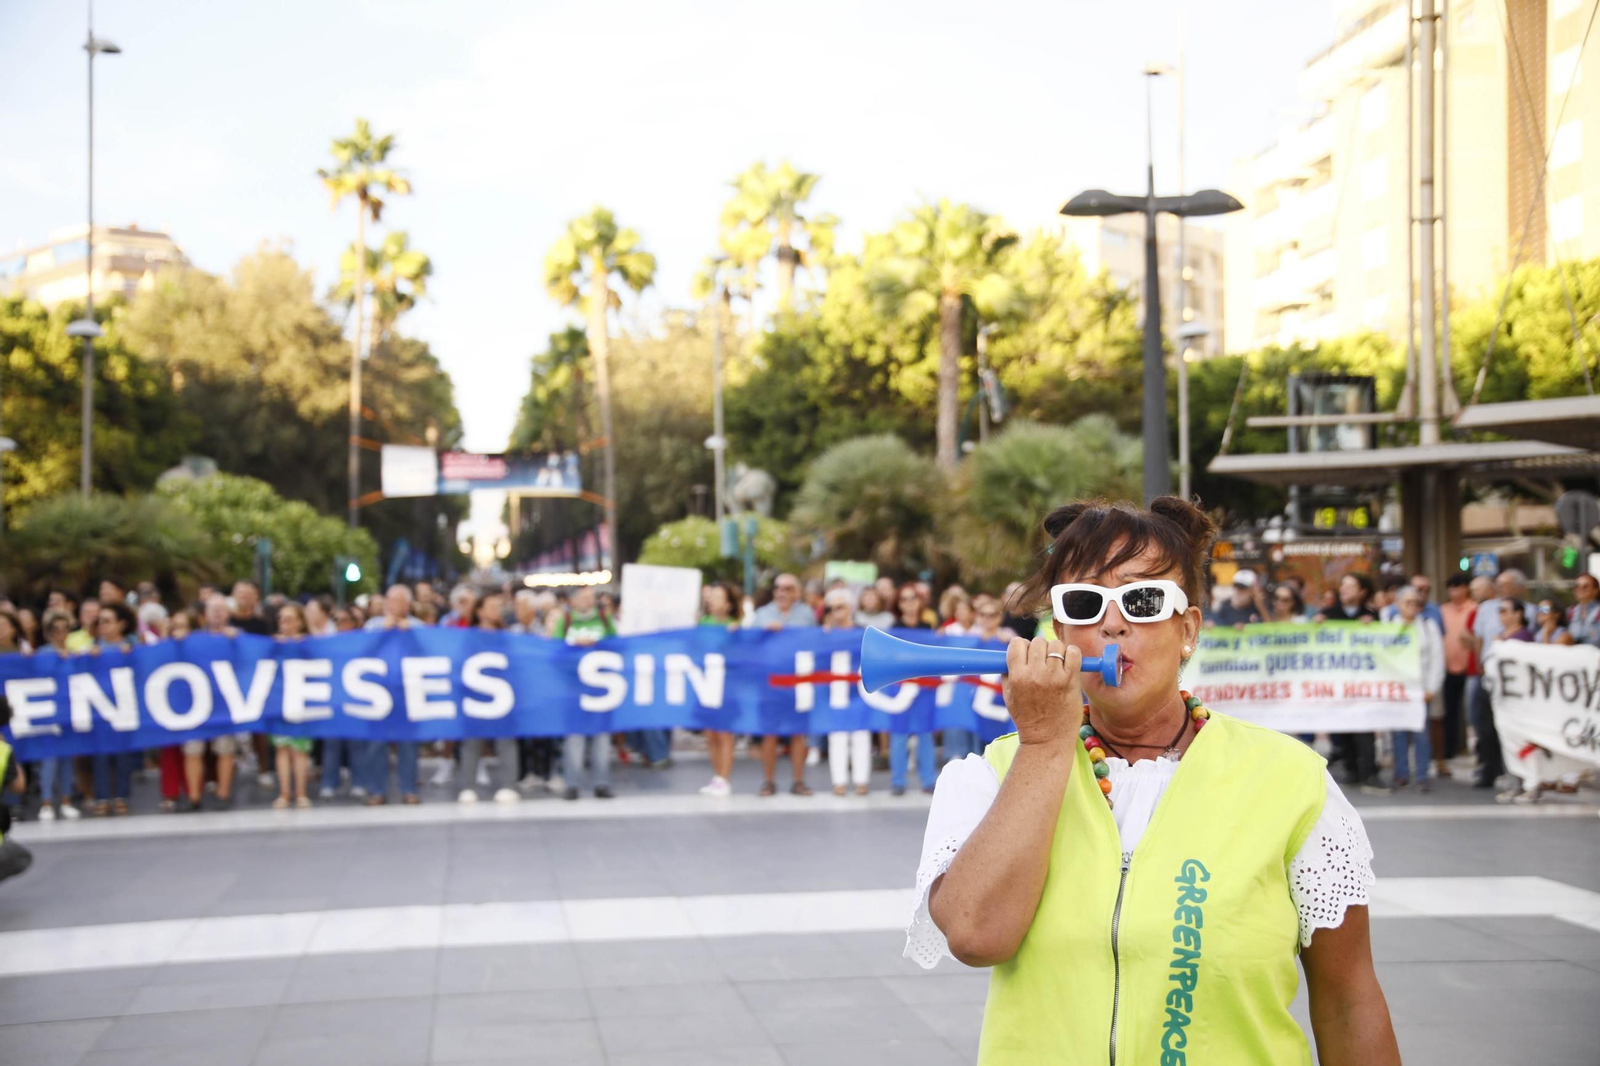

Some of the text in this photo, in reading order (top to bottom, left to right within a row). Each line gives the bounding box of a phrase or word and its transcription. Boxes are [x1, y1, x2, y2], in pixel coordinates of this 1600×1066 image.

[577, 650, 726, 713] SIN
[1265, 652, 1376, 676] QUEREMOS
[1193, 680, 1408, 702] GENOVESES SIN HOTEL
[1160, 858, 1211, 1066] GREENPEACE
